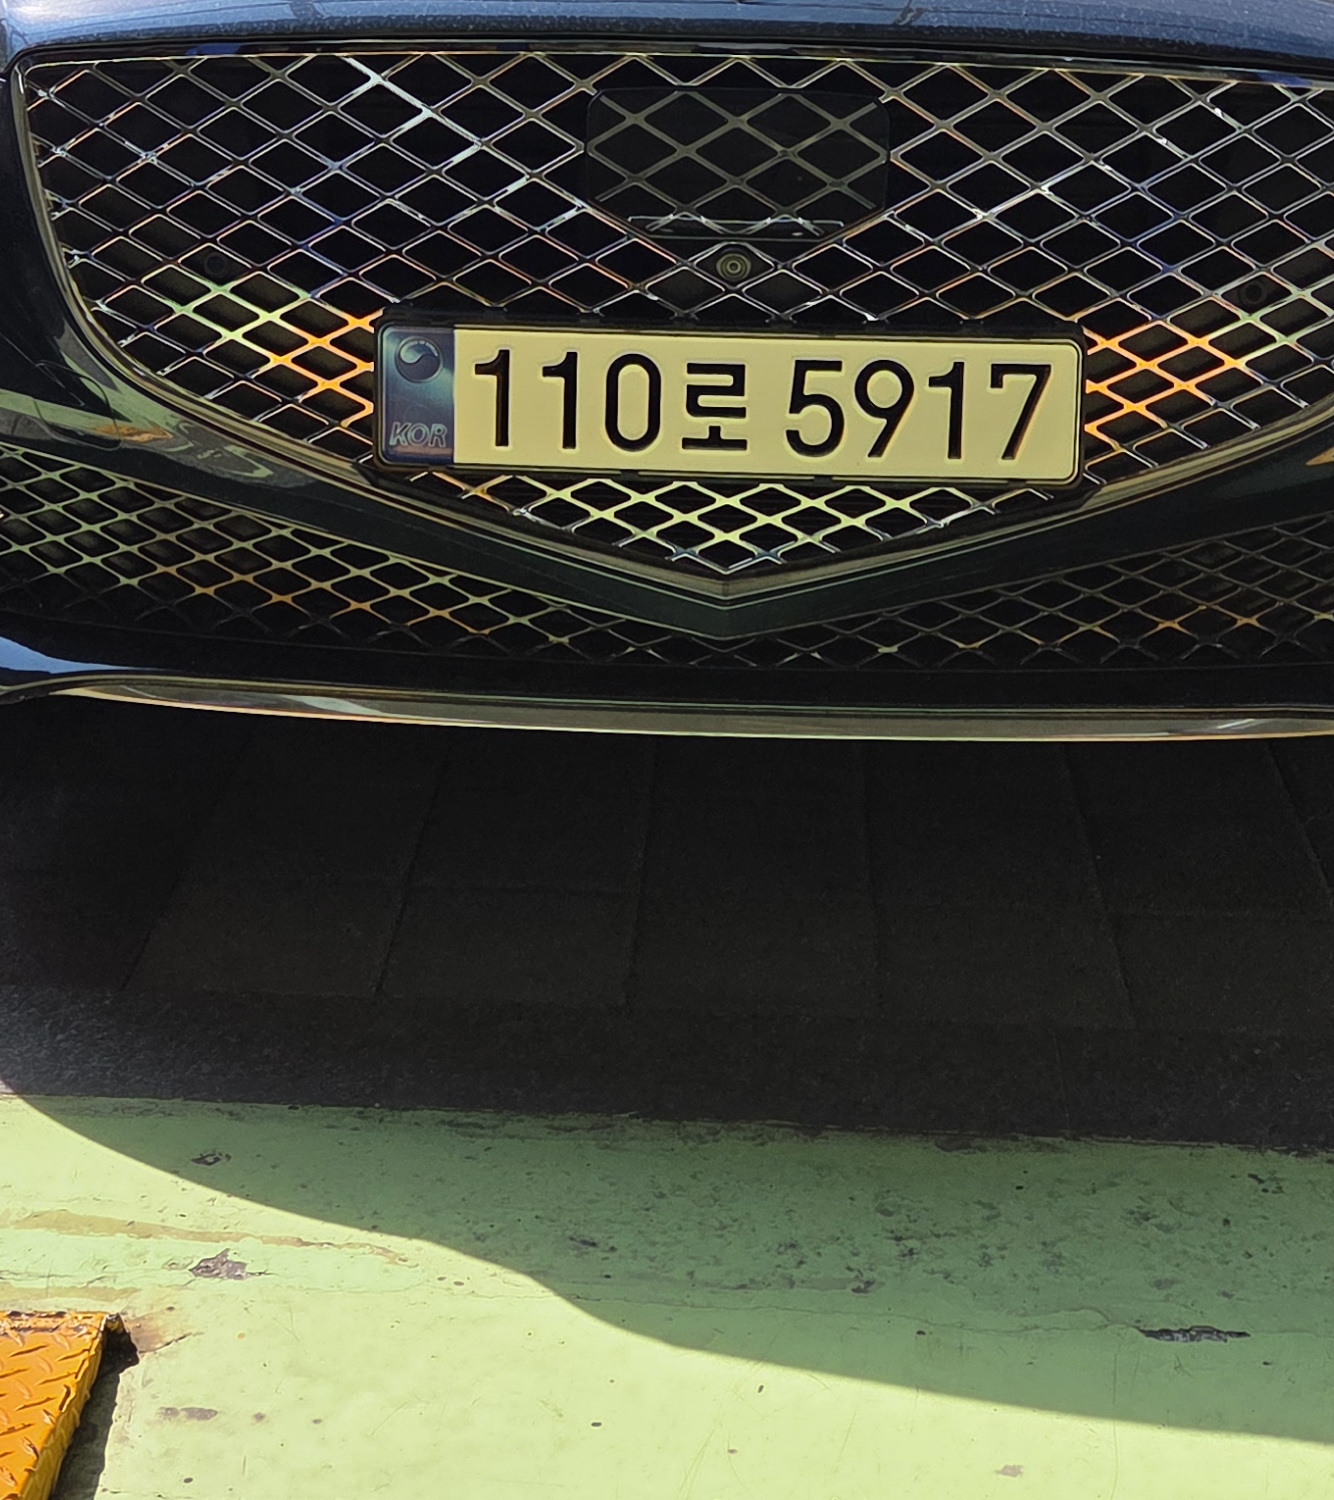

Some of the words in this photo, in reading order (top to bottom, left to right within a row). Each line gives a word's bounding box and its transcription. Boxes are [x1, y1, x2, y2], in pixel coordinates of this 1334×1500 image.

[389, 421, 448, 448] KOR
[474, 348, 748, 451] 110로
[785, 359, 1053, 461] 5917
